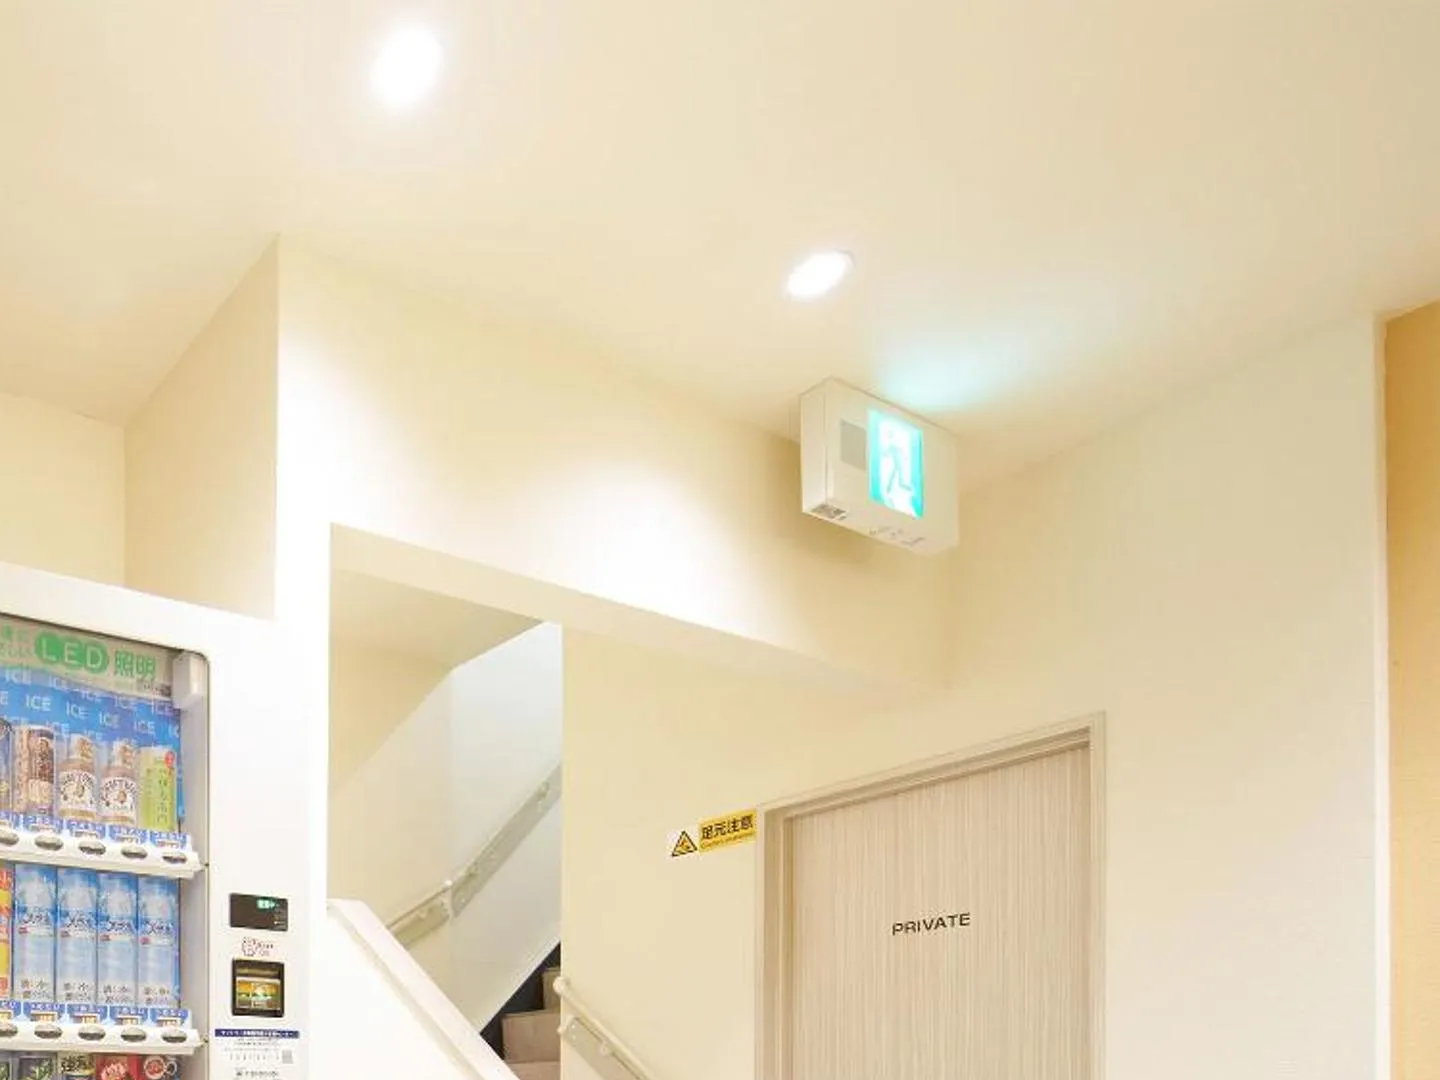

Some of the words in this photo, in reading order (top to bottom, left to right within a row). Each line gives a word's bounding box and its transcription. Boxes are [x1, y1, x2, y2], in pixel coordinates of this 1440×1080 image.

[26, 695, 51, 711] ICE
[66, 702, 89, 719] ICE
[99, 713, 120, 726] ICE
[134, 719, 156, 736] ICE
[701, 814, 753, 840] 足元注意
[891, 912, 971, 936] PRIVATE
